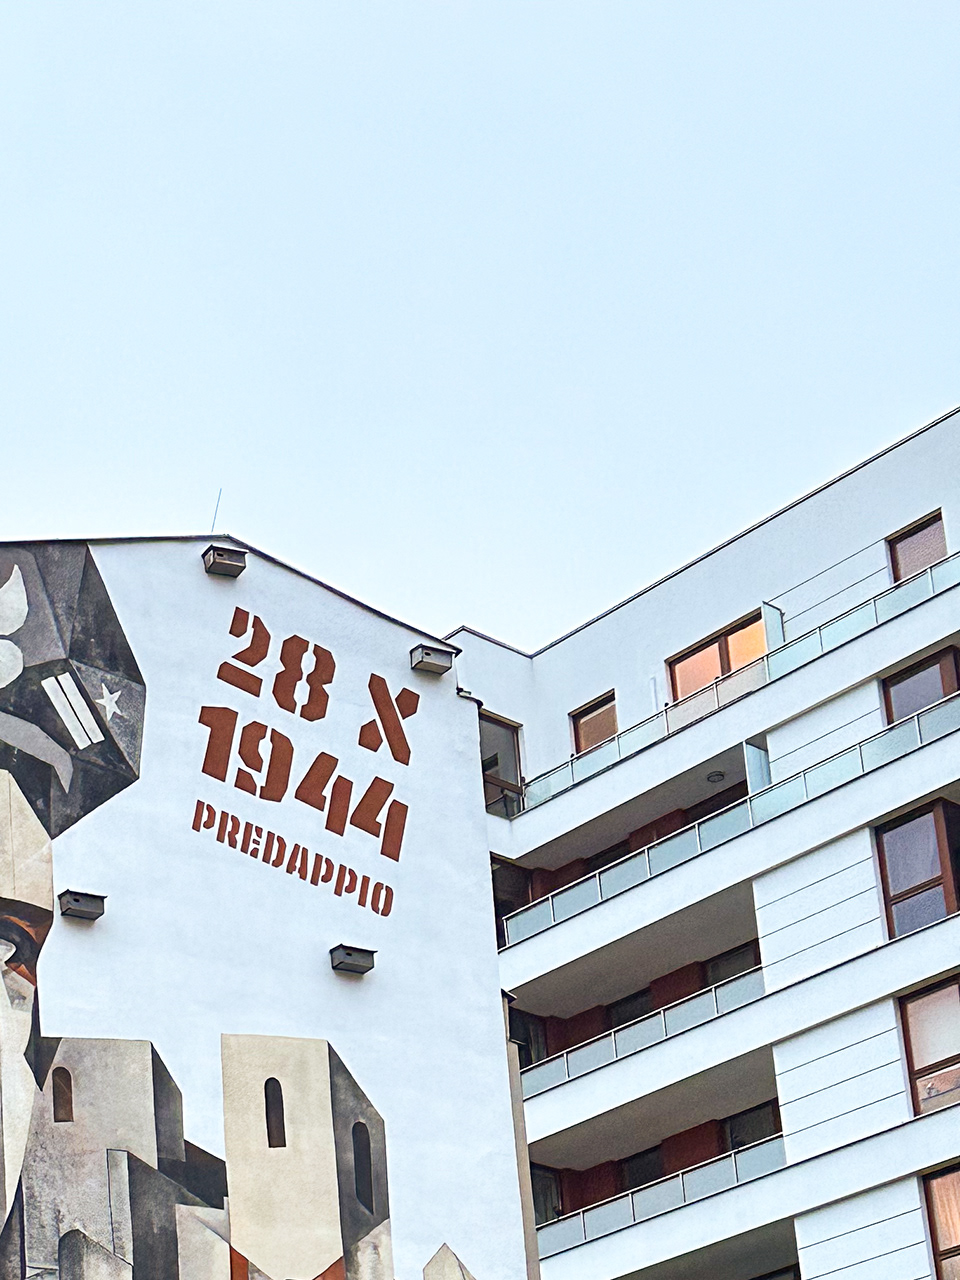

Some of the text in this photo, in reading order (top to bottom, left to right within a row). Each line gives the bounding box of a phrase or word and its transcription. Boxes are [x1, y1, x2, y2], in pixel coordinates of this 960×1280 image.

[217, 606, 421, 766] 28 X
[192, 800, 394, 917] PREDAPPIO
[197, 706, 409, 863] 1944
